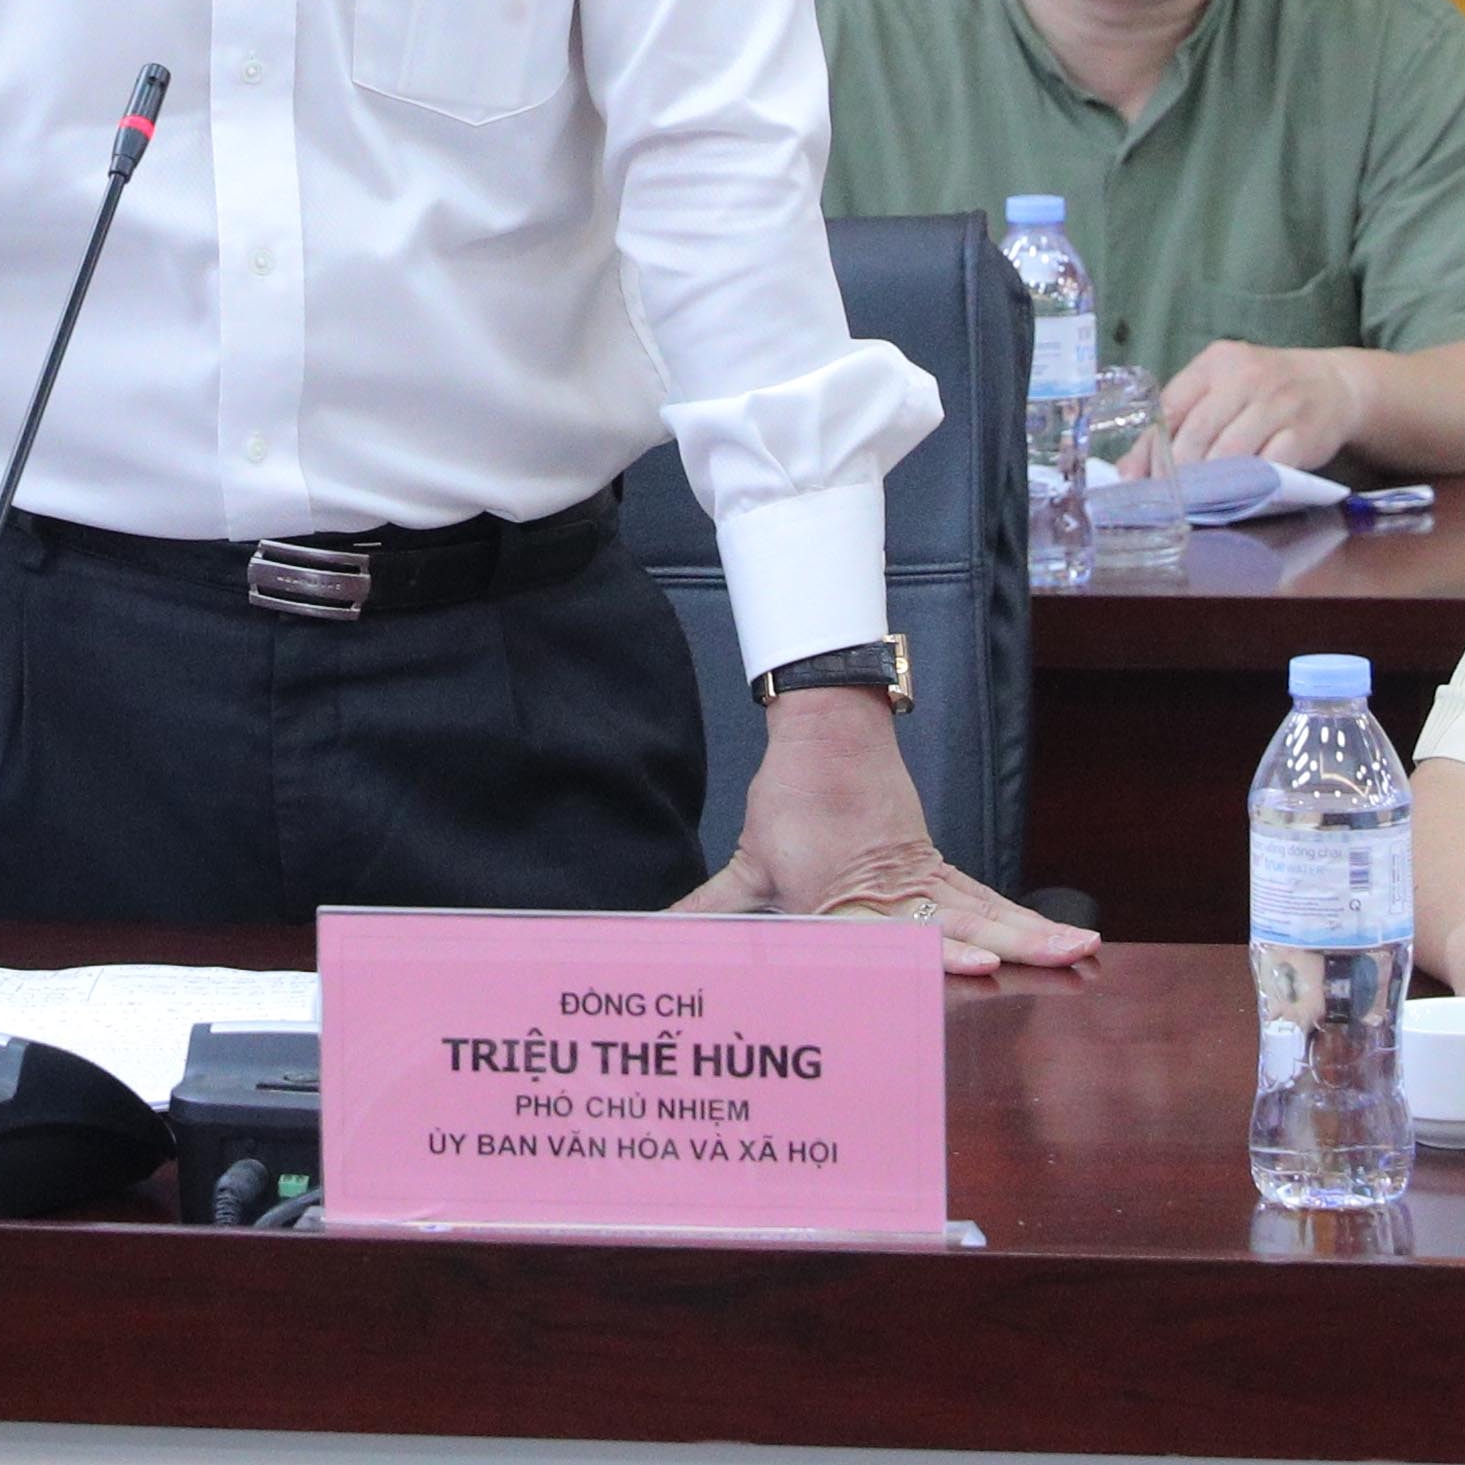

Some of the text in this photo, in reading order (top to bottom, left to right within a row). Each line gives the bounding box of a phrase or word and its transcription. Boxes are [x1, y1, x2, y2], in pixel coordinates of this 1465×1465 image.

[559, 987, 705, 1019] ĐỒNG CHÍ
[442, 1027, 823, 1083] TRIỆU THẾ HÙNG
[514, 1089, 751, 1127] PHÓ CHỦ NHIỆM
[428, 1127, 838, 1170] ỦY BAN VĂN HÓA VÀ XÃ HỘI
